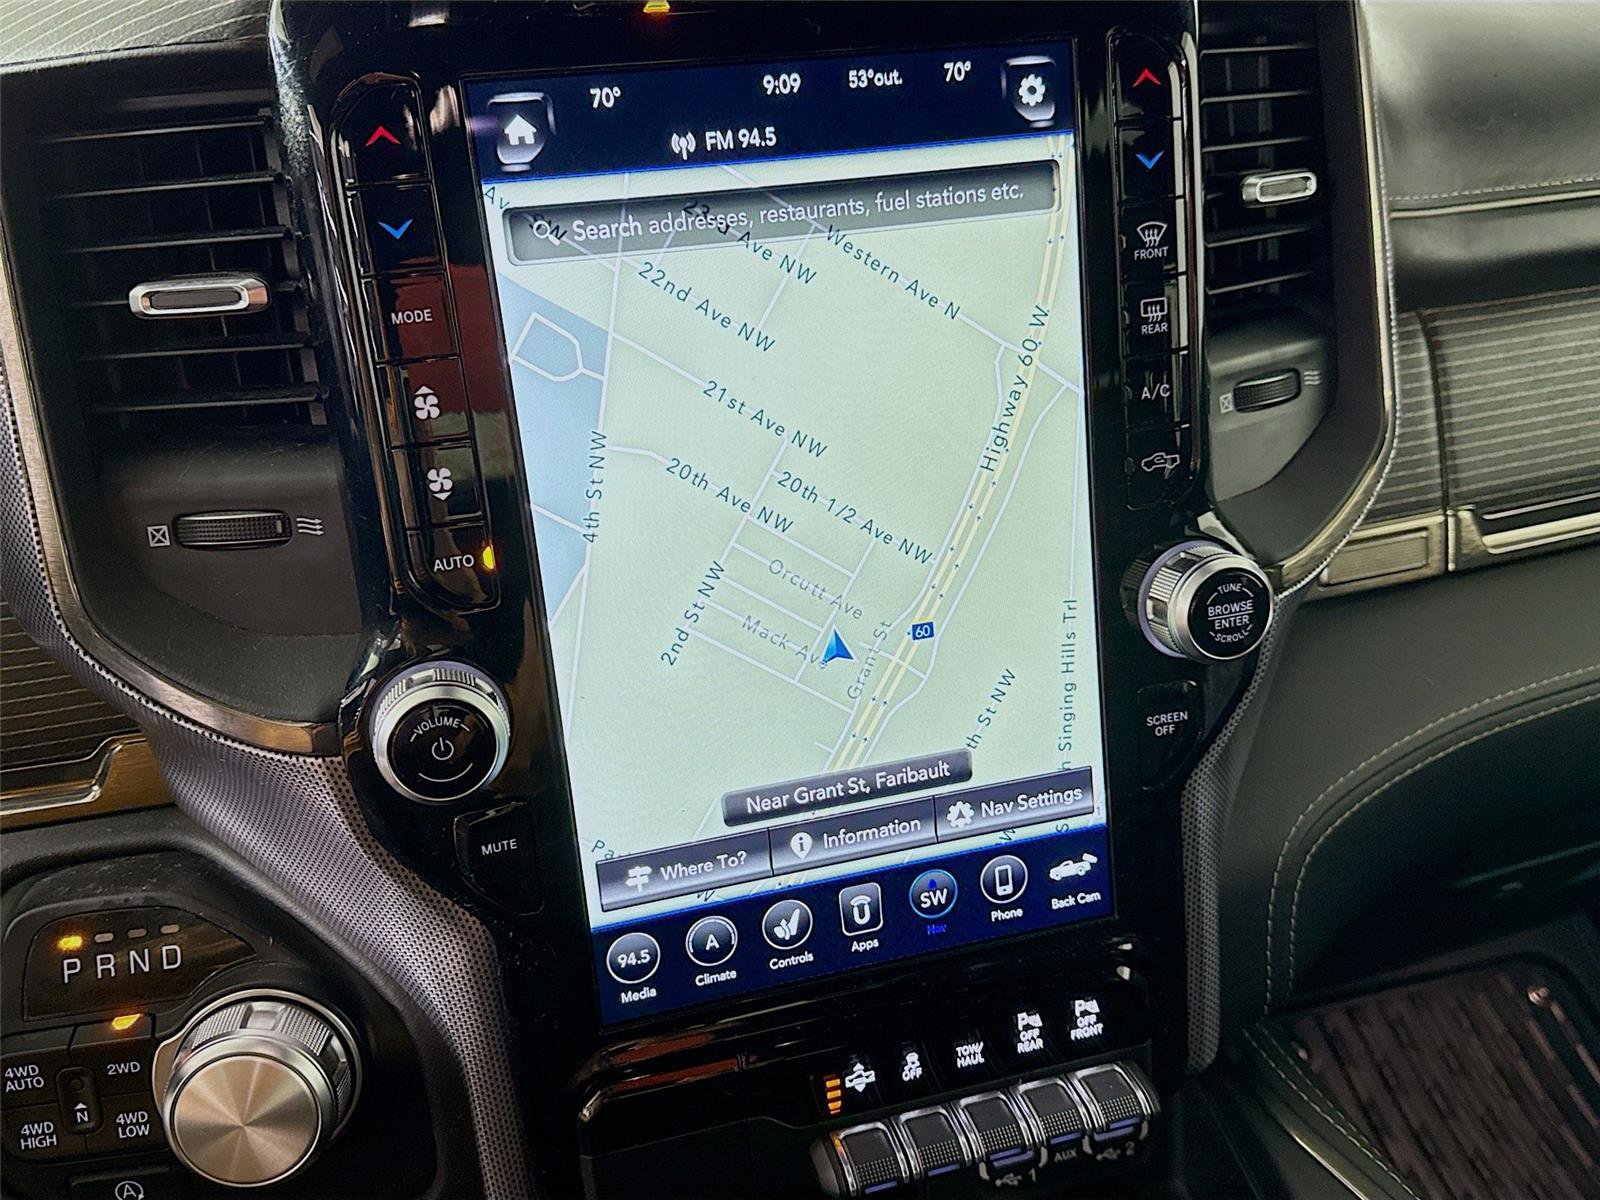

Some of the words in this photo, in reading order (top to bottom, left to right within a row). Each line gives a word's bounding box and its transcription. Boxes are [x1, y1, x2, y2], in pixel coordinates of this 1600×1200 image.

[944, 60, 971, 82] 70°
[763, 72, 801, 95] 9:09
[590, 86, 621, 108] 70°
[706, 130, 734, 152] FM
[738, 126, 776, 149] 94.5
[572, 214, 642, 242] Search
[648, 210, 753, 234] addresses,
[760, 197, 870, 224] restaurants,
[876, 190, 910, 212] fuel
[916, 185, 986, 208] stations
[991, 184, 1024, 200] etc.
[737, 231, 772, 260] Ave
[780, 254, 817, 284] NW
[1134, 246, 1168, 260] FRONT
[827, 224, 899, 284] Western
[905, 279, 938, 308] Ave
[944, 301, 961, 320] N
[390, 308, 432, 325] MODE
[638, 262, 692, 302] 22nd
[696, 299, 732, 328] Ave
[738, 322, 776, 352] NW
[1141, 322, 1168, 335] REAR
[980, 375, 1028, 472] Highway
[1018, 338, 1038, 367] 60
[1029, 304, 1049, 328] W
[1141, 384, 1171, 400] A/C
[703, 380, 746, 414] 21st
[750, 409, 786, 436] Ave
[791, 430, 828, 458] NW
[588, 430, 607, 470] NW
[586, 478, 604, 500] St
[666, 457, 709, 491] 20th
[716, 486, 751, 513] Ave
[757, 506, 794, 533] NW
[778, 471, 818, 504] 20th
[826, 498, 857, 524] 1/2
[860, 519, 894, 544] Ave
[898, 538, 933, 564] NW
[582, 511, 600, 544] 4th
[433, 554, 475, 573] AUTO
[768, 559, 827, 600] Orcutt
[830, 592, 863, 620] Ave
[1217, 583, 1243, 594] TUNE
[660, 627, 690, 666] 2nd
[684, 602, 706, 624] St
[698, 560, 725, 598] NW
[1063, 600, 1078, 623] Trl
[1208, 599, 1254, 618] BROWSE
[915, 624, 931, 638] 60
[1214, 615, 1250, 630] ENTER
[742, 615, 790, 650] Mack
[1215, 630, 1248, 644] SCROLL
[847, 648, 880, 700] Grant
[873, 620, 892, 640] St
[1060, 631, 1076, 674] Hills
[978, 707, 997, 727] St
[990, 668, 1016, 703] NW
[413, 716, 461, 735] VOLUME
[1058, 682, 1077, 752] Singing
[1146, 710, 1188, 727] SCREEN
[1155, 724, 1176, 736] OFF
[746, 793, 789, 814] Near
[794, 781, 844, 804] Grant
[847, 777, 870, 795] St,
[874, 759, 951, 790] Faribault
[981, 800, 1014, 818] Nav
[1017, 787, 1083, 811] Settings
[823, 818, 921, 848] Information
[481, 838, 518, 856] MUTE
[660, 861, 713, 881] Where
[716, 850, 748, 870] To?
[920, 888, 948, 908] SW
[1052, 896, 1076, 910] Back
[1077, 891, 1102, 904] Cam
[990, 907, 1024, 922] Phone
[850, 938, 880, 953] Apps
[63, 958, 81, 984] P
[96, 954, 116, 979] R
[129, 949, 150, 974] N
[162, 944, 182, 970] D
[617, 948, 651, 969] 94.5
[769, 951, 814, 970] Controls
[695, 969, 737, 986] Climate
[620, 986, 657, 1004] Media
[1076, 1014, 1097, 1028] OFF
[1020, 1028, 1040, 1042] OFF
[1070, 1022, 1104, 1041] FRONT
[956, 1041, 984, 1057] TOW/
[1017, 1038, 1044, 1054] REAR
[106, 1061, 141, 1076] 2WD
[956, 1053, 985, 1069] HAUL
[4, 1064, 40, 1078] 4WD
[902, 1067, 922, 1082] OFF
[4, 1077, 45, 1093] AUTO
[76, 1110, 89, 1124] N
[116, 1110, 148, 1125] 4WD
[20, 1121, 54, 1136] 4WD
[118, 1124, 150, 1140] LOW
[20, 1134, 58, 1150] HIGH
[1054, 1148, 1078, 1163] AUX
[1028, 1168, 1037, 1182] 1
